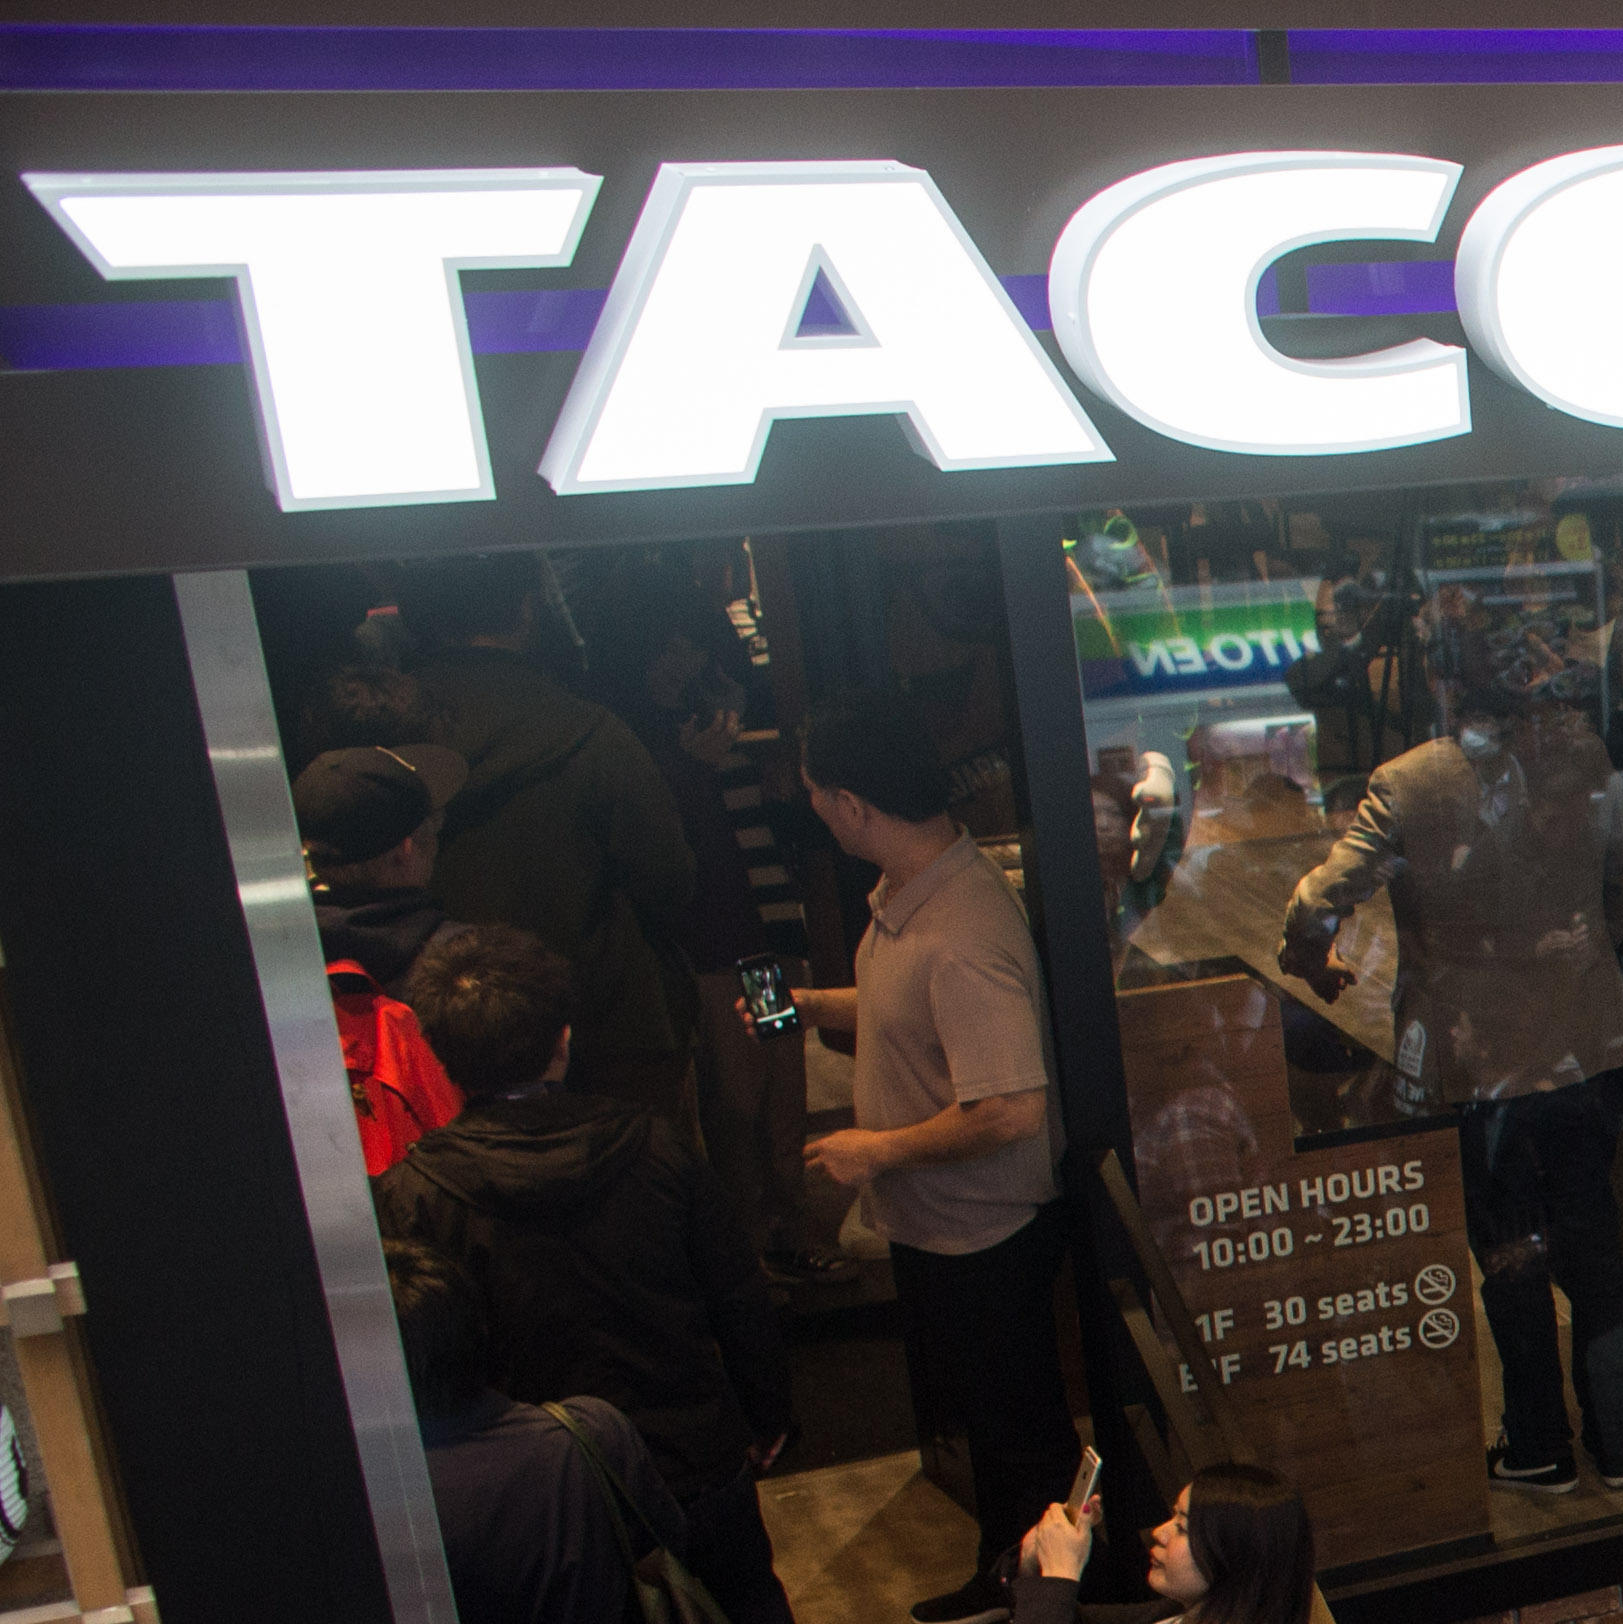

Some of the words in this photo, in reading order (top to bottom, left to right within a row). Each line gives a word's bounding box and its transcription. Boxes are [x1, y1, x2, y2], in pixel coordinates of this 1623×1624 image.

[1189, 1183, 1290, 1227] OPEN
[1301, 1161, 1425, 1208] HOURS
[1193, 1227, 1294, 1271] 10:00
[1333, 1203, 1430, 1247] 23:00
[1195, 1309, 1235, 1343] 1F
[1264, 1295, 1307, 1330] 30
[1318, 1279, 1409, 1320] seats
[1179, 1353, 1242, 1393] BF
[1268, 1341, 1312, 1376] 74
[1321, 1322, 1412, 1365] seats
